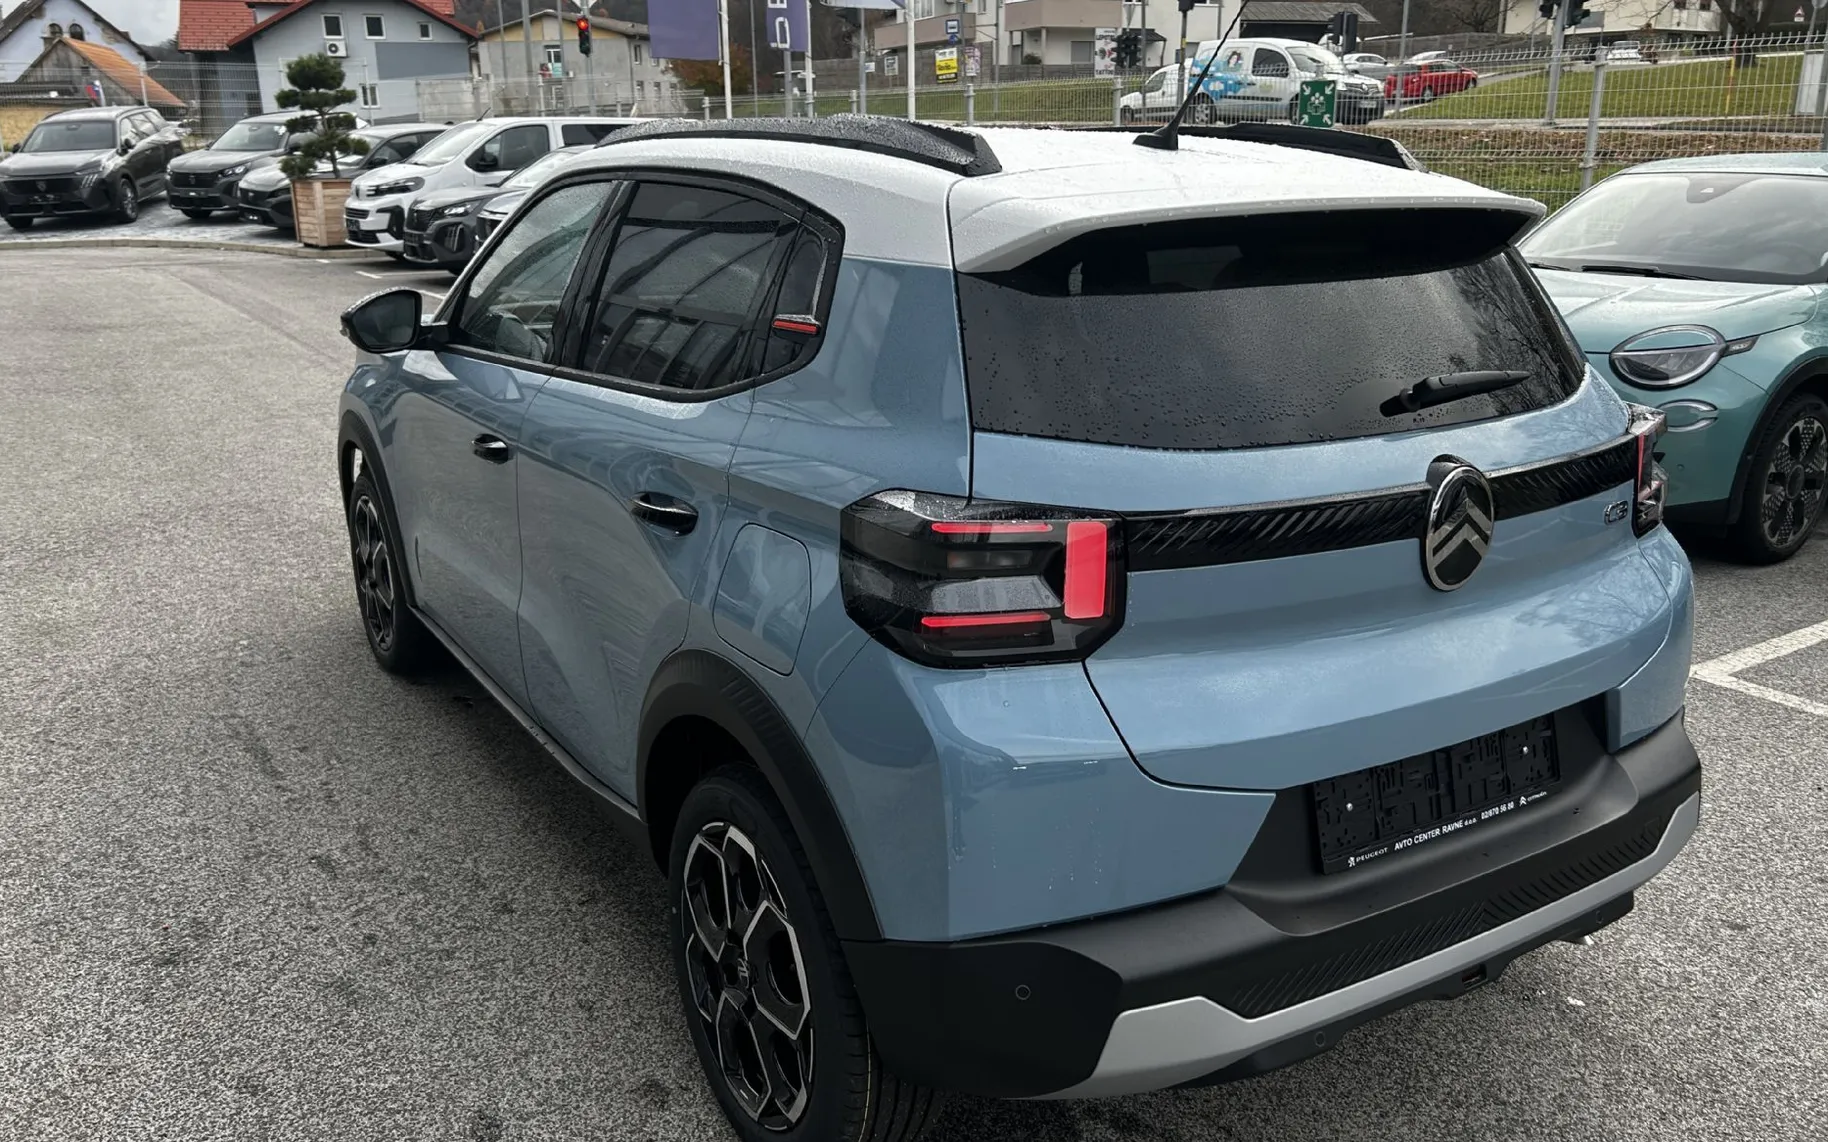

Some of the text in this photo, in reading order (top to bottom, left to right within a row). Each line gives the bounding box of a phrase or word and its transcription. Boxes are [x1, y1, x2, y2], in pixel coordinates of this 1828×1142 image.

[1604, 501, 1628, 524] C3
[1394, 838, 1413, 851] AVTO
[1413, 828, 1441, 844] CENTER
[1441, 819, 1463, 834] RAVNE
[1356, 847, 1388, 862] PEUGEOT
